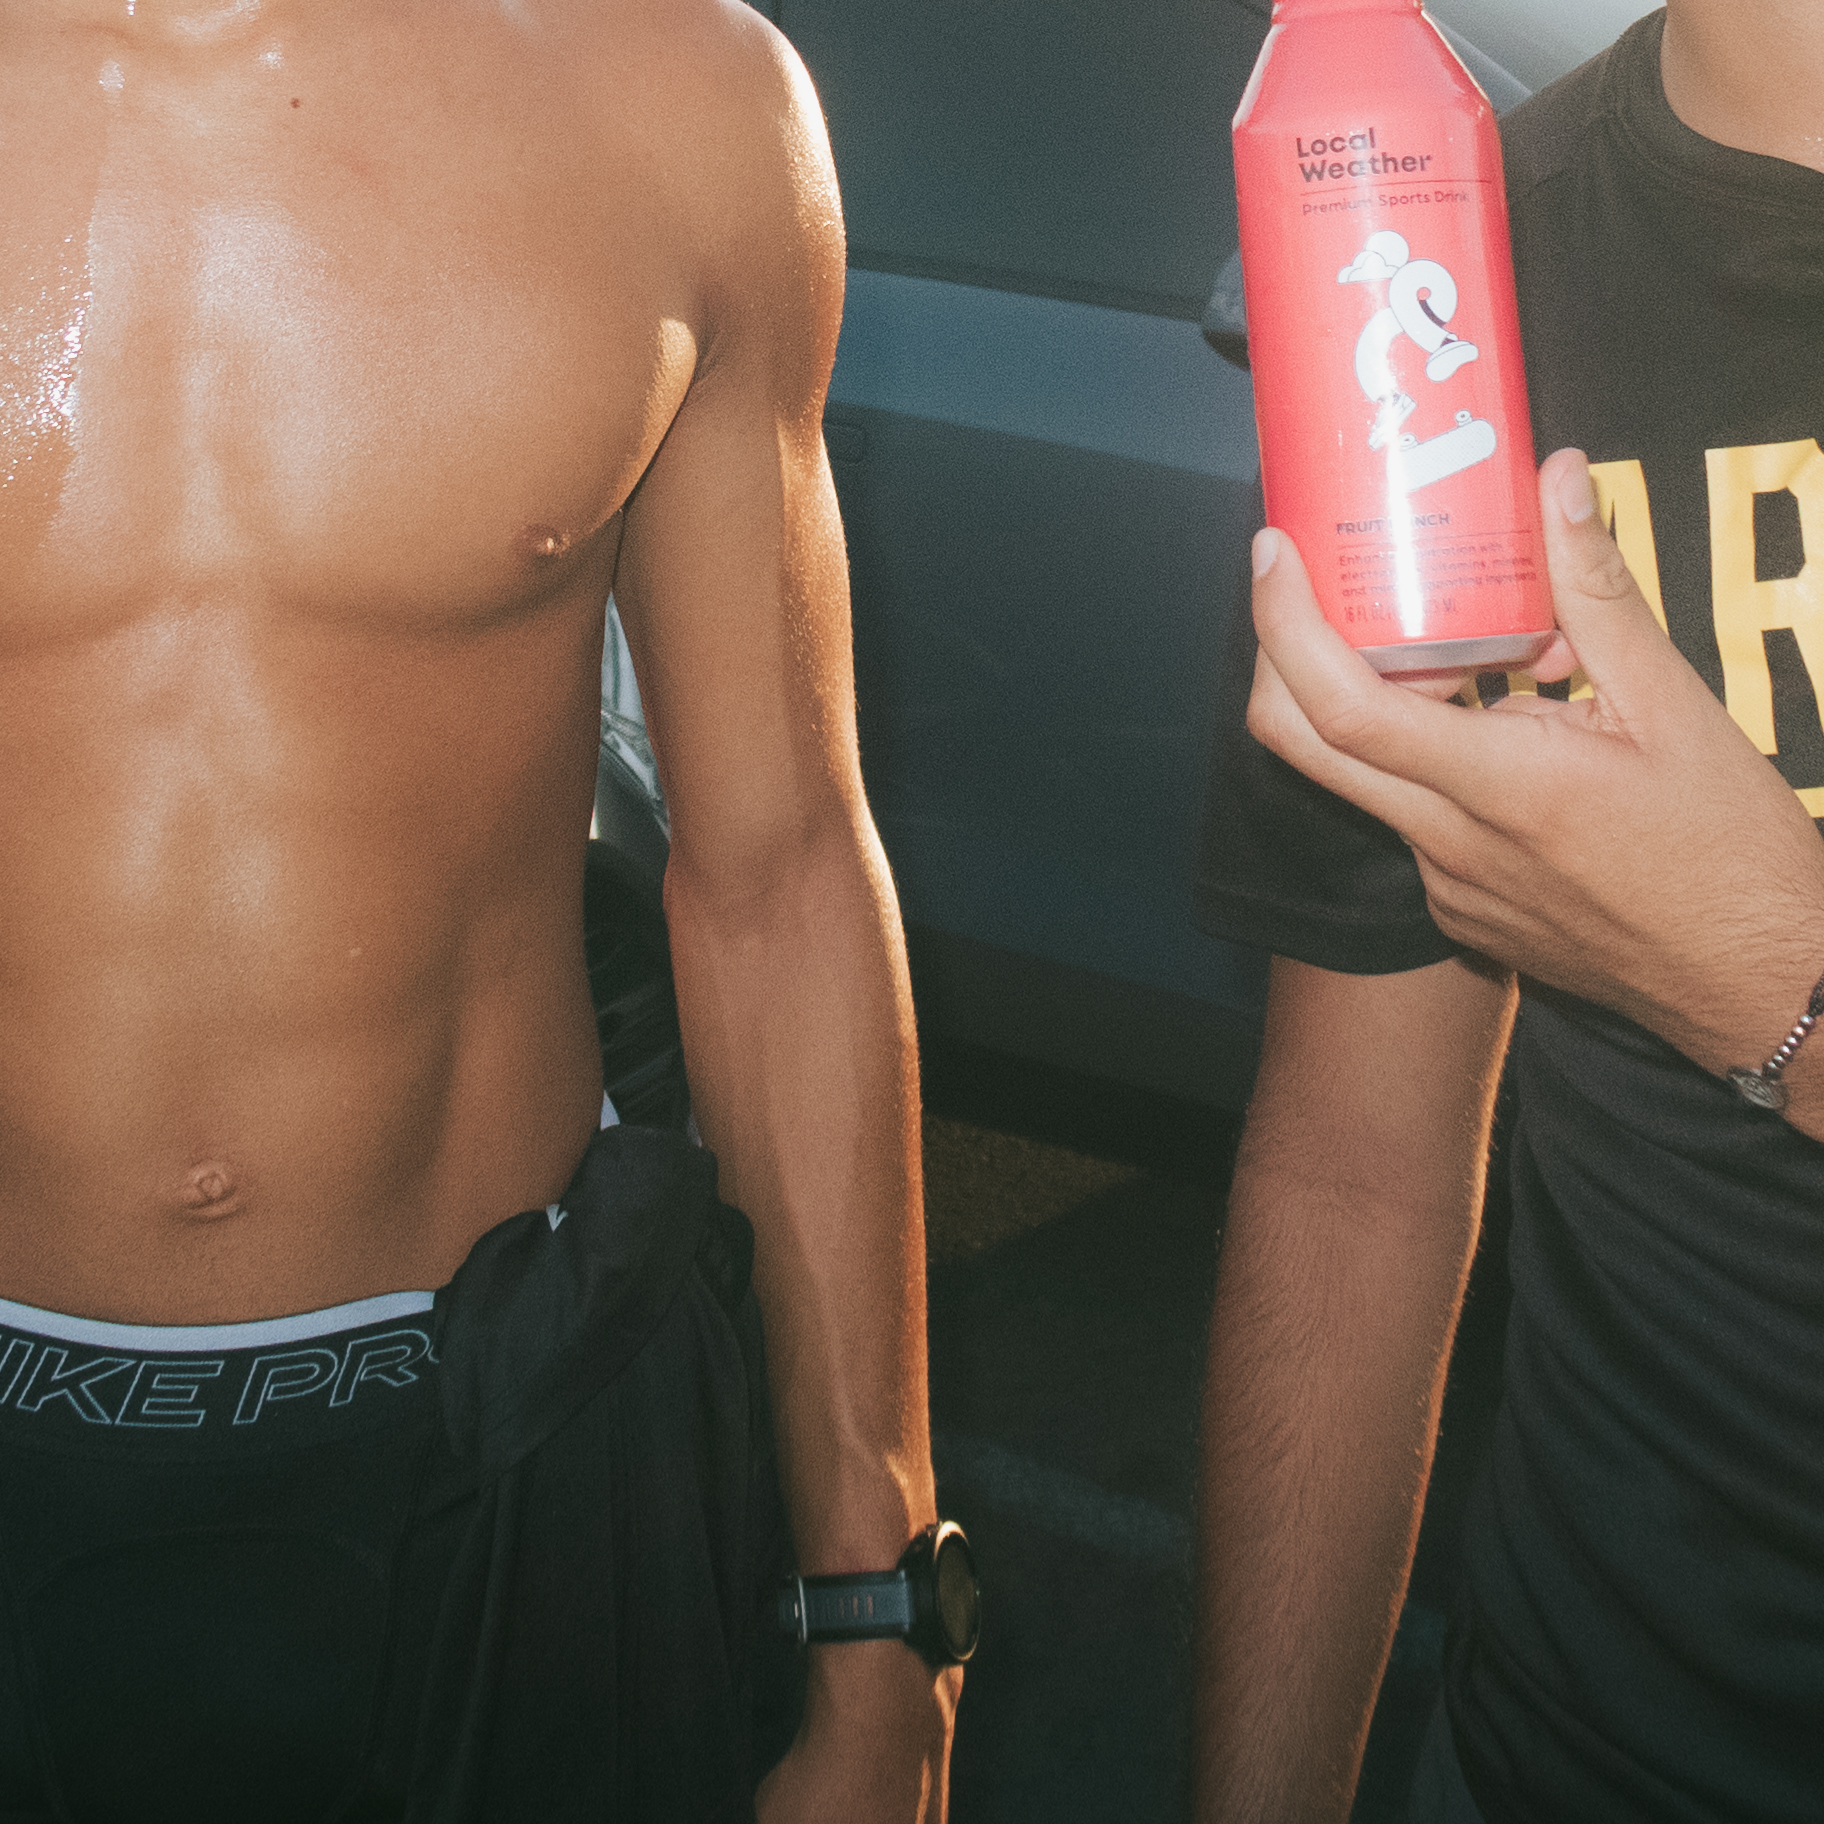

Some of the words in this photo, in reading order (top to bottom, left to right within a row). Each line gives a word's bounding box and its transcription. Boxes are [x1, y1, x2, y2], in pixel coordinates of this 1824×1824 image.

[1296, 127, 1376, 158] Local
[1298, 152, 1433, 183] Weather
[1302, 198, 1372, 217] Premium
[1378, 191, 1431, 207] Sports
[1434, 190, 1469, 203] Drink
[1336, 518, 1383, 535] FRUIT
[232, 1328, 440, 1426] PR
